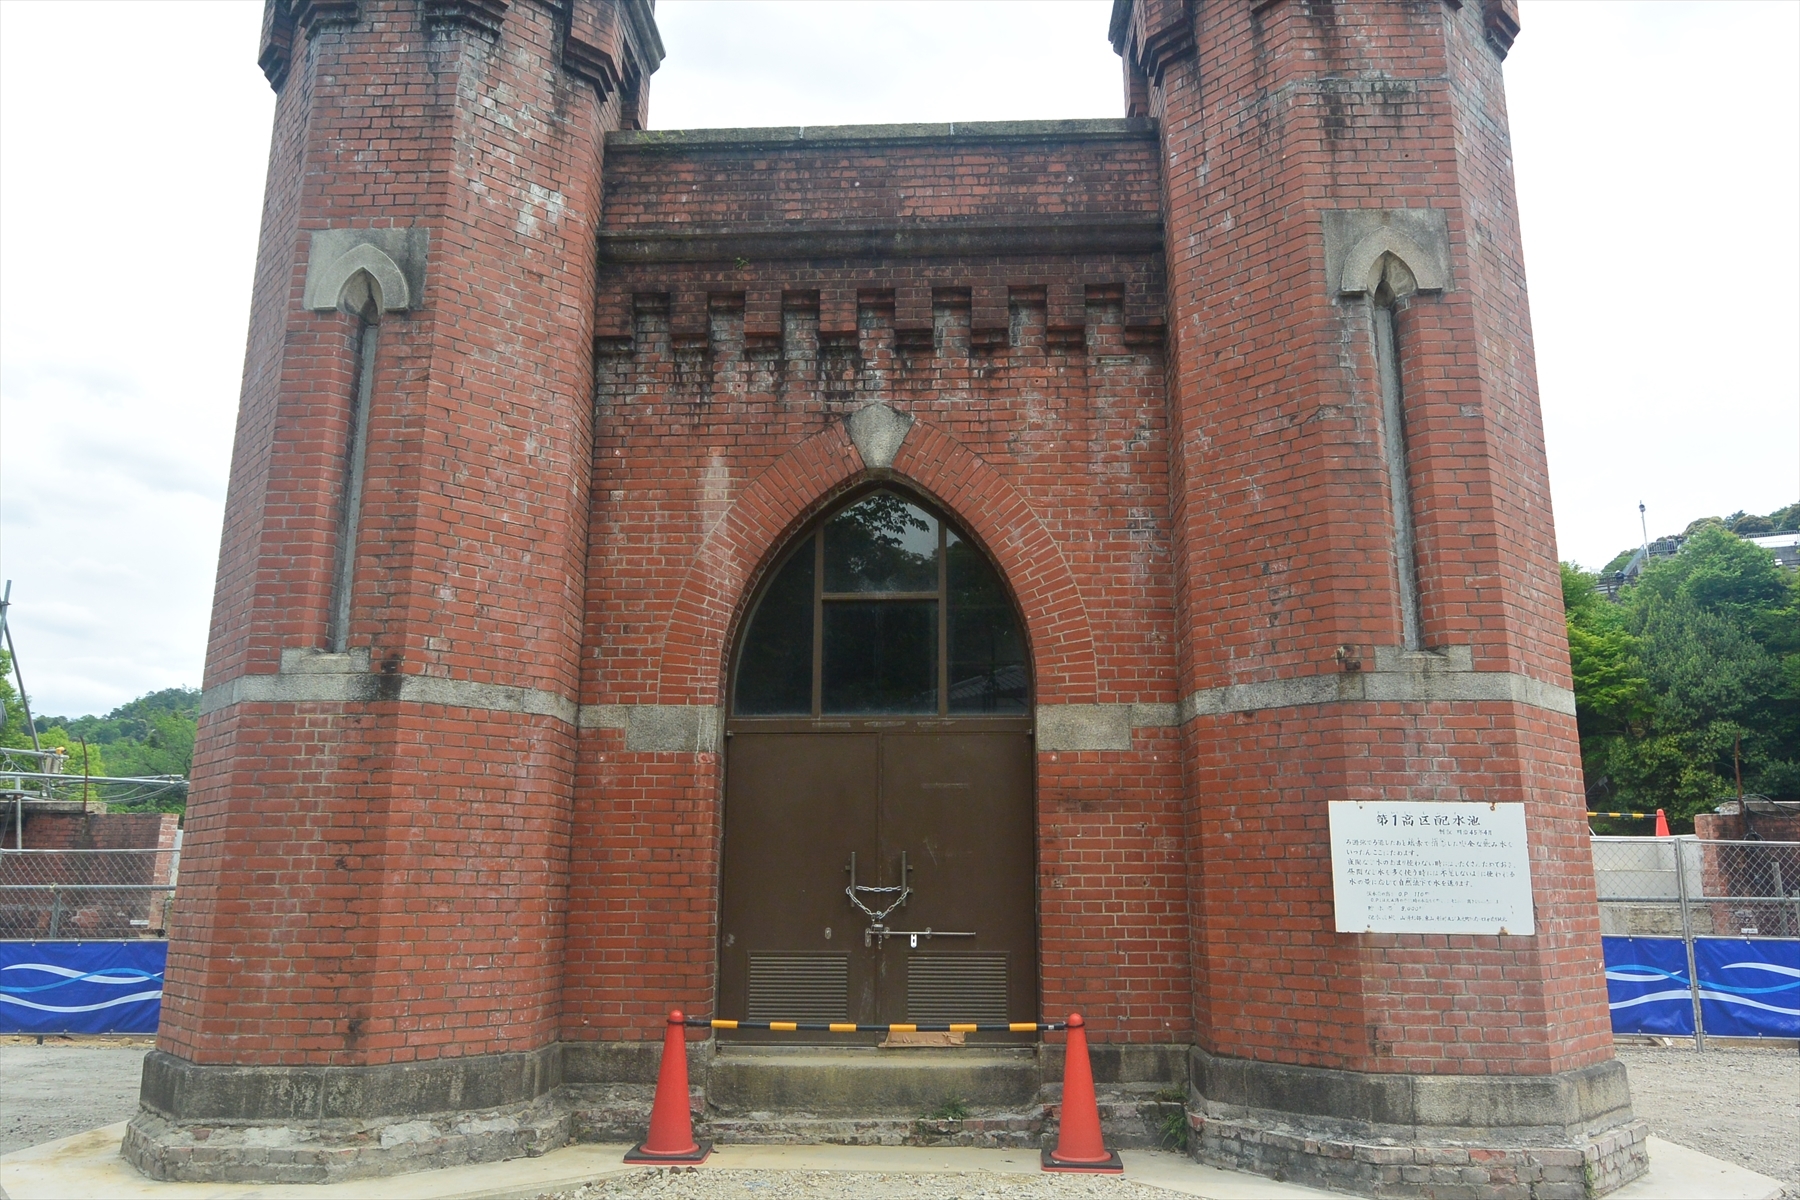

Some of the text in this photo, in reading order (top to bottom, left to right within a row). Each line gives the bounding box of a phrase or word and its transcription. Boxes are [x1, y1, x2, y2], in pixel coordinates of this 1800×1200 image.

[1376, 814, 1481, 827] 第1高区配水池
